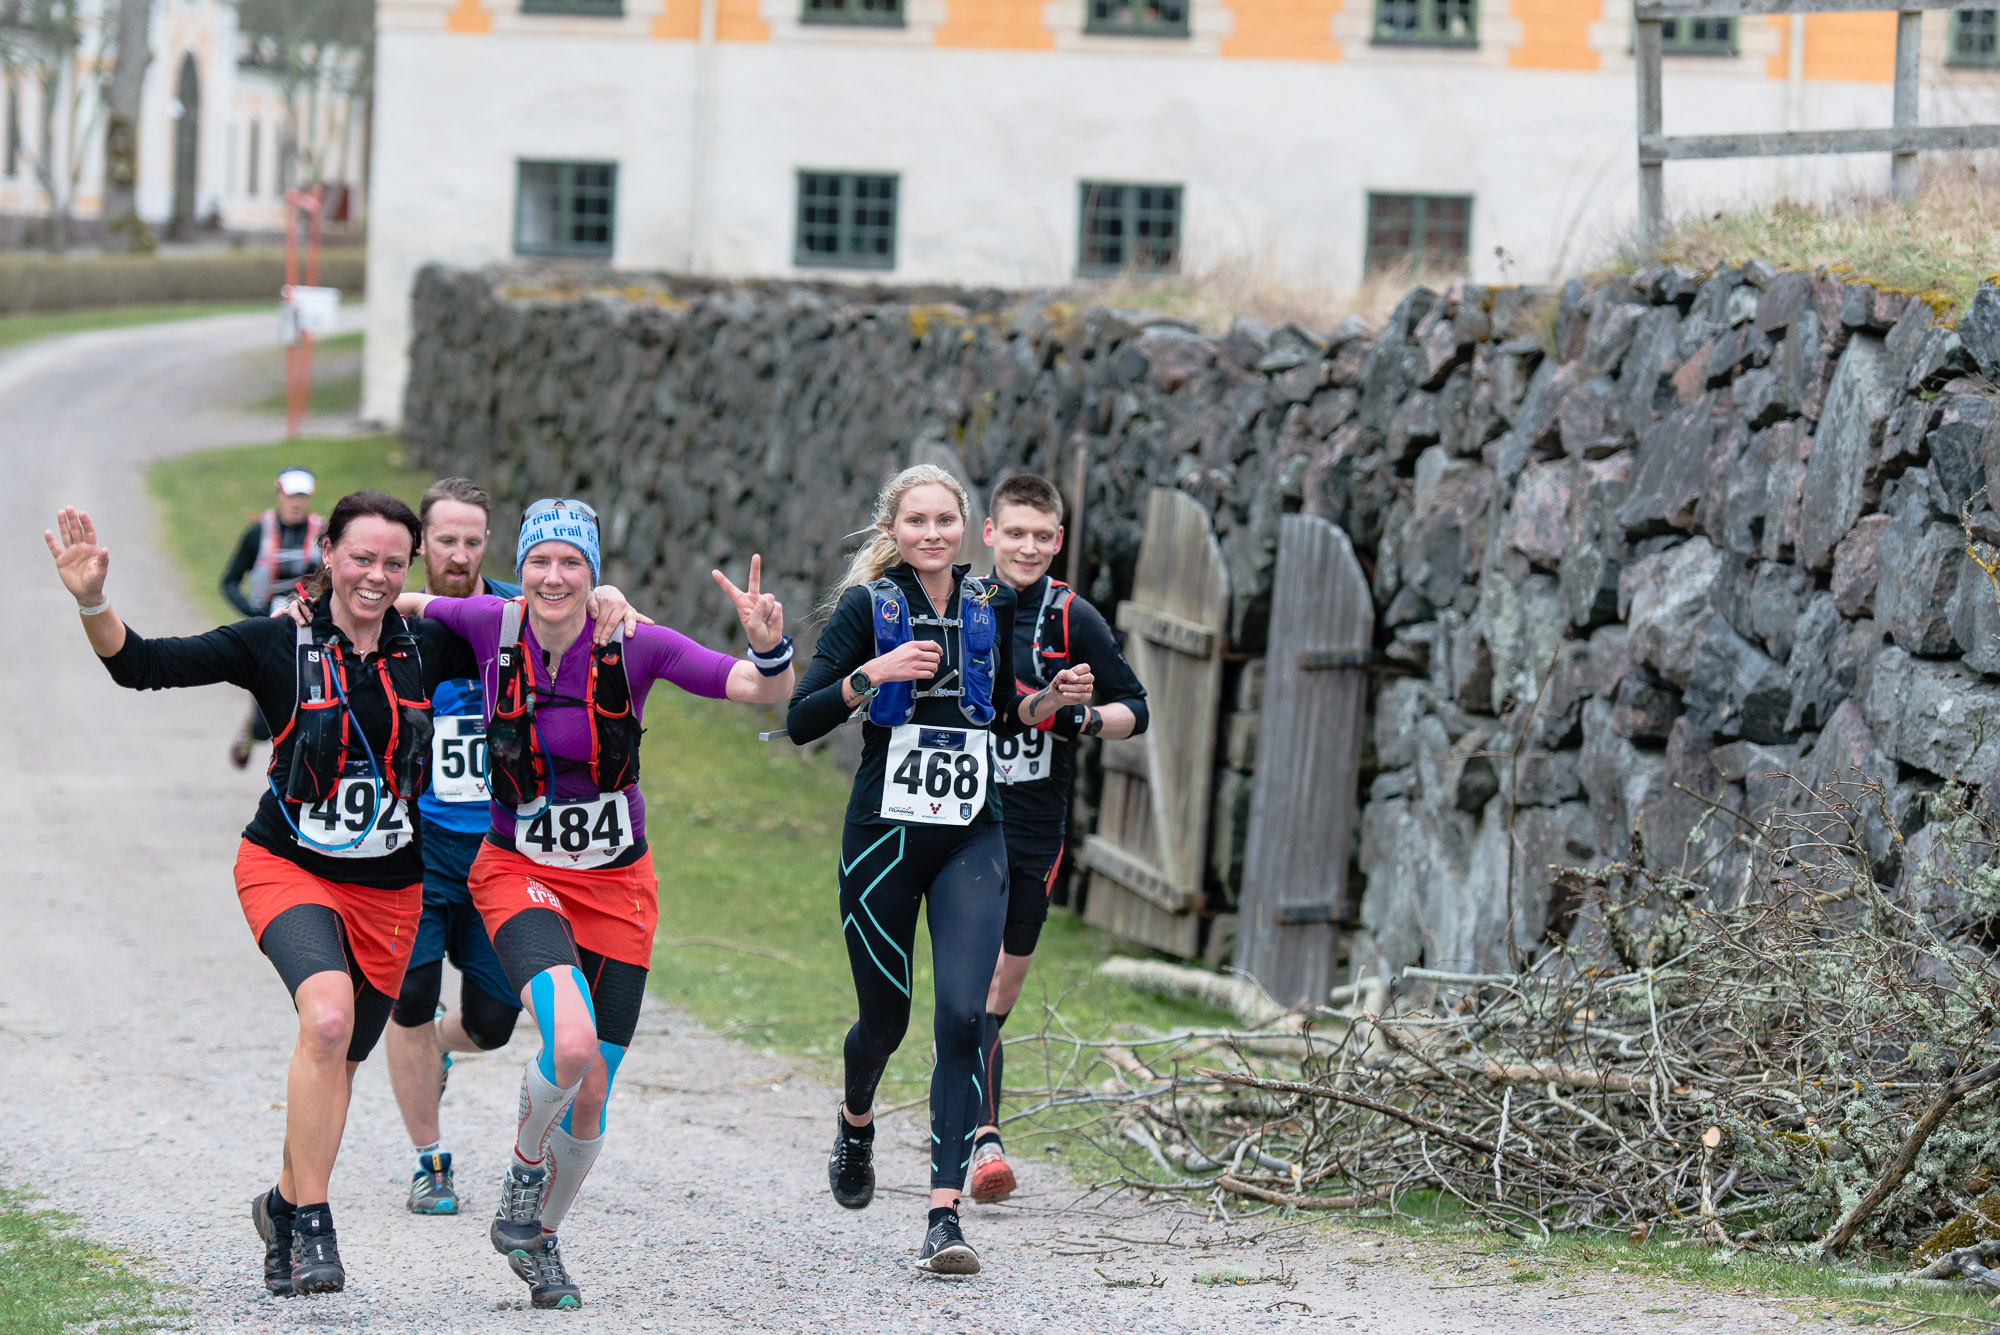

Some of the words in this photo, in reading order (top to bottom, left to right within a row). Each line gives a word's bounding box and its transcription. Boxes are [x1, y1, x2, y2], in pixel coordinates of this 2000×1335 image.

[522, 527, 544, 549] trail
[553, 525, 582, 538] trail
[532, 509, 560, 526] trail
[990, 728, 1045, 760] 69
[893, 749, 979, 800] 468
[309, 781, 403, 831] 492
[525, 799, 624, 853] 484
